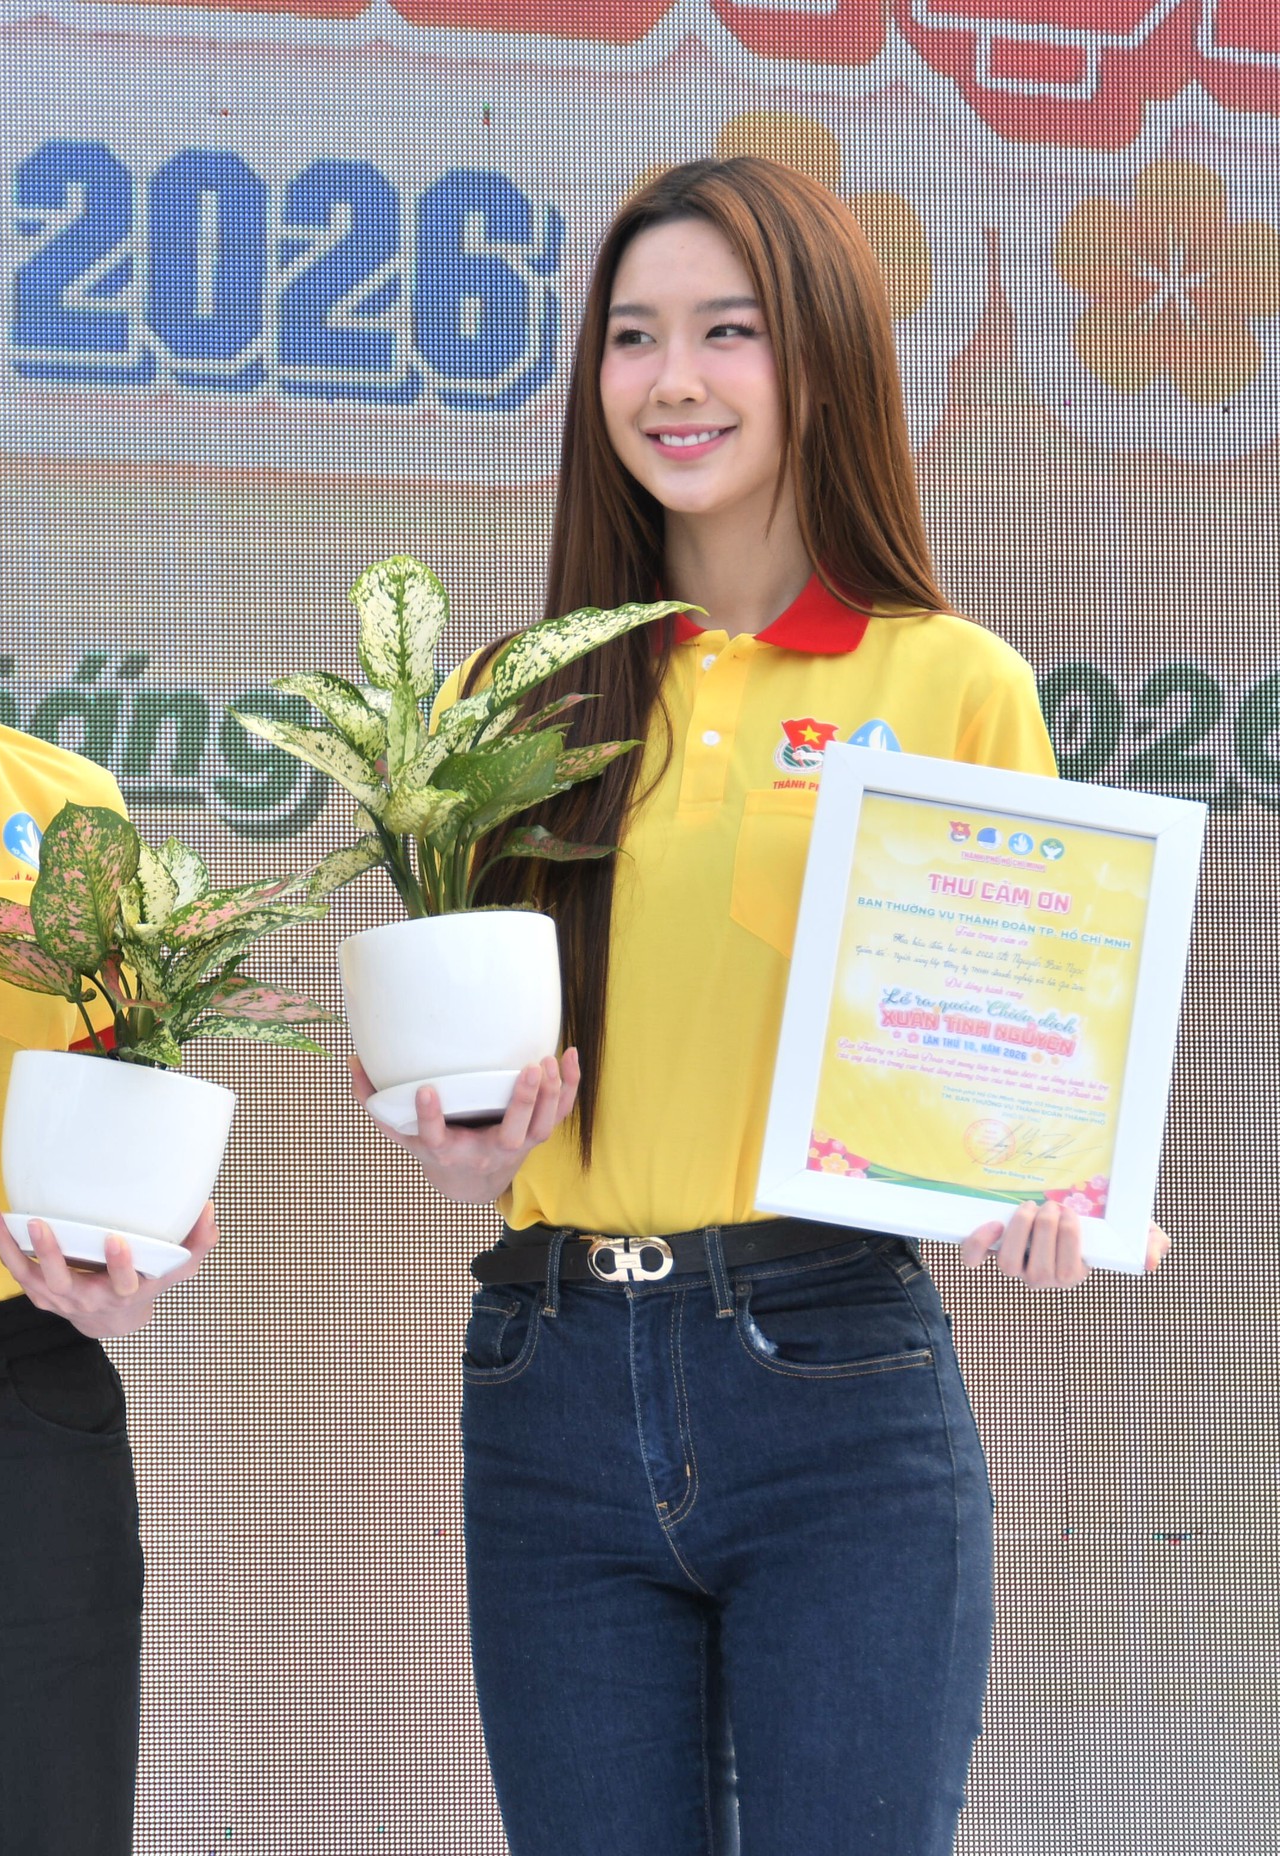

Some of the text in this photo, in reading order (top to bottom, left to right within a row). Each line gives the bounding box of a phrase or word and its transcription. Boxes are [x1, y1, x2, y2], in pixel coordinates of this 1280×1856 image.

[10, 138, 565, 410] 2026
[928, 873, 1069, 912] THƯ CẢM ƠN
[857, 896, 1131, 948] BAN THƯỜNG VỤ THÀNH ĐOÀN TP. HỒ CHÍ MNH
